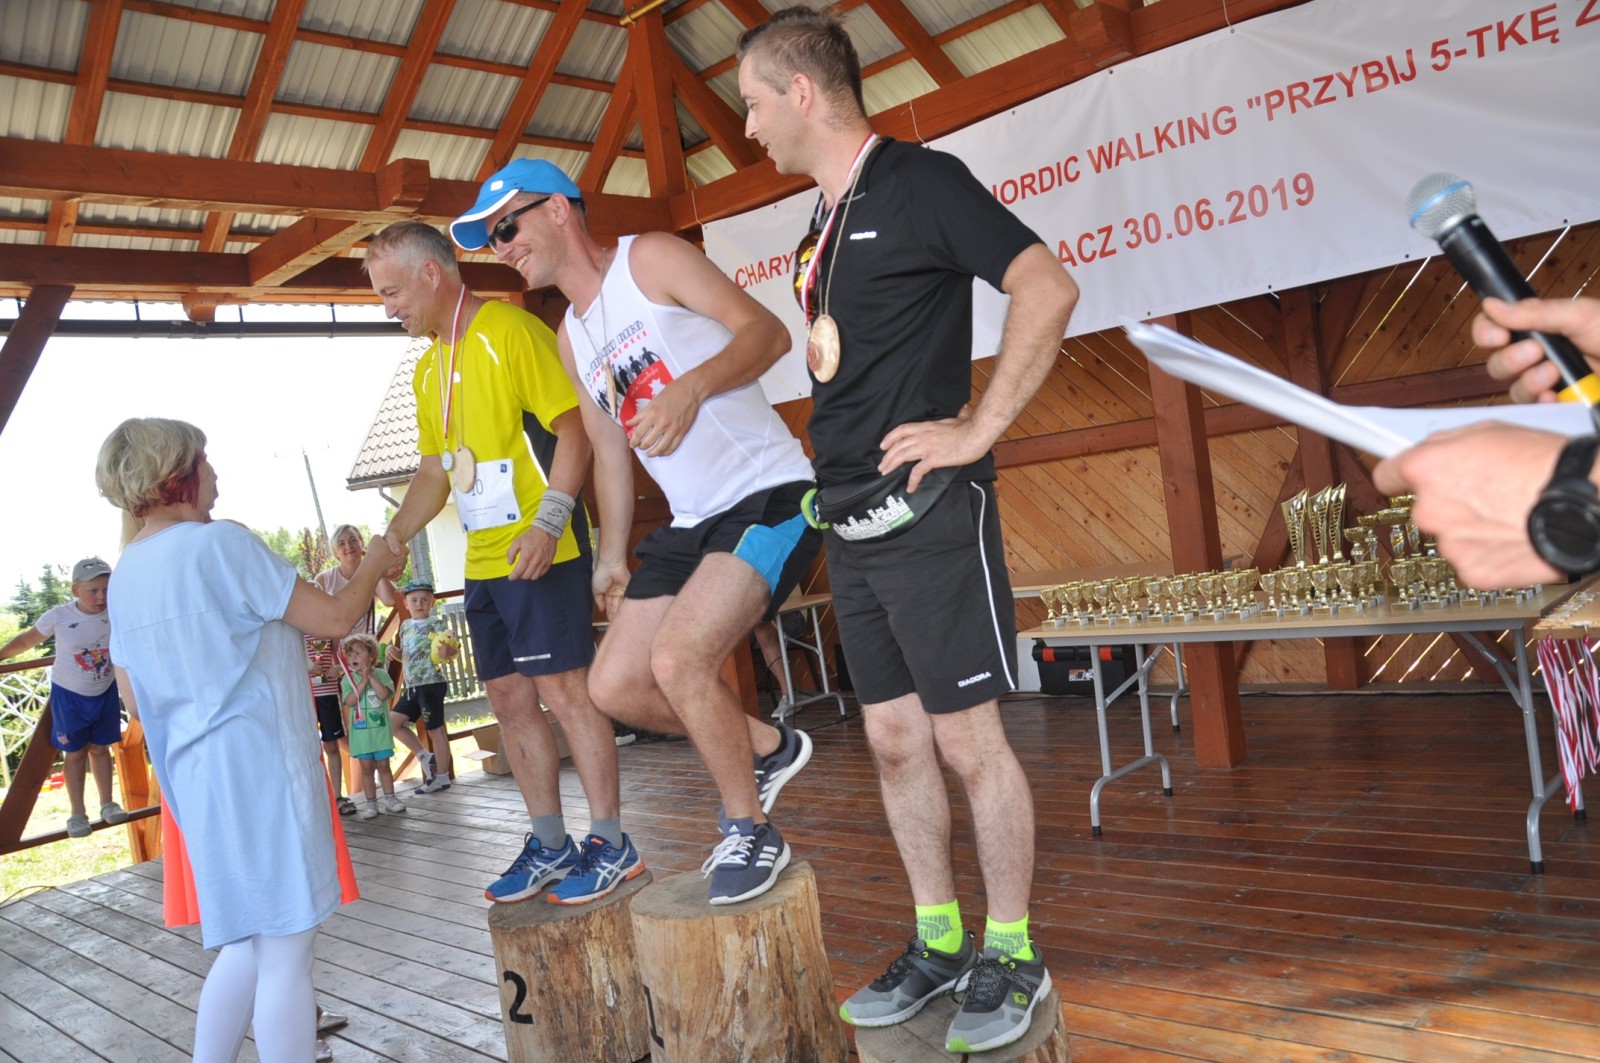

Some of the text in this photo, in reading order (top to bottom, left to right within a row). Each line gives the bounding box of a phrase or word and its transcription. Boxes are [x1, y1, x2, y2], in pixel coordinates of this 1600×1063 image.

[735, 250, 798, 290] CHARY
[1086, 105, 1238, 174] WALKING
[1246, 48, 1418, 122] "PRZYBIJ
[1430, 3, 1560, 72] 5-TKĘ
[1056, 172, 1315, 268] ACZ 30.06.2019
[957, 671, 992, 688] DIADORA
[502, 970, 534, 1025] 2
